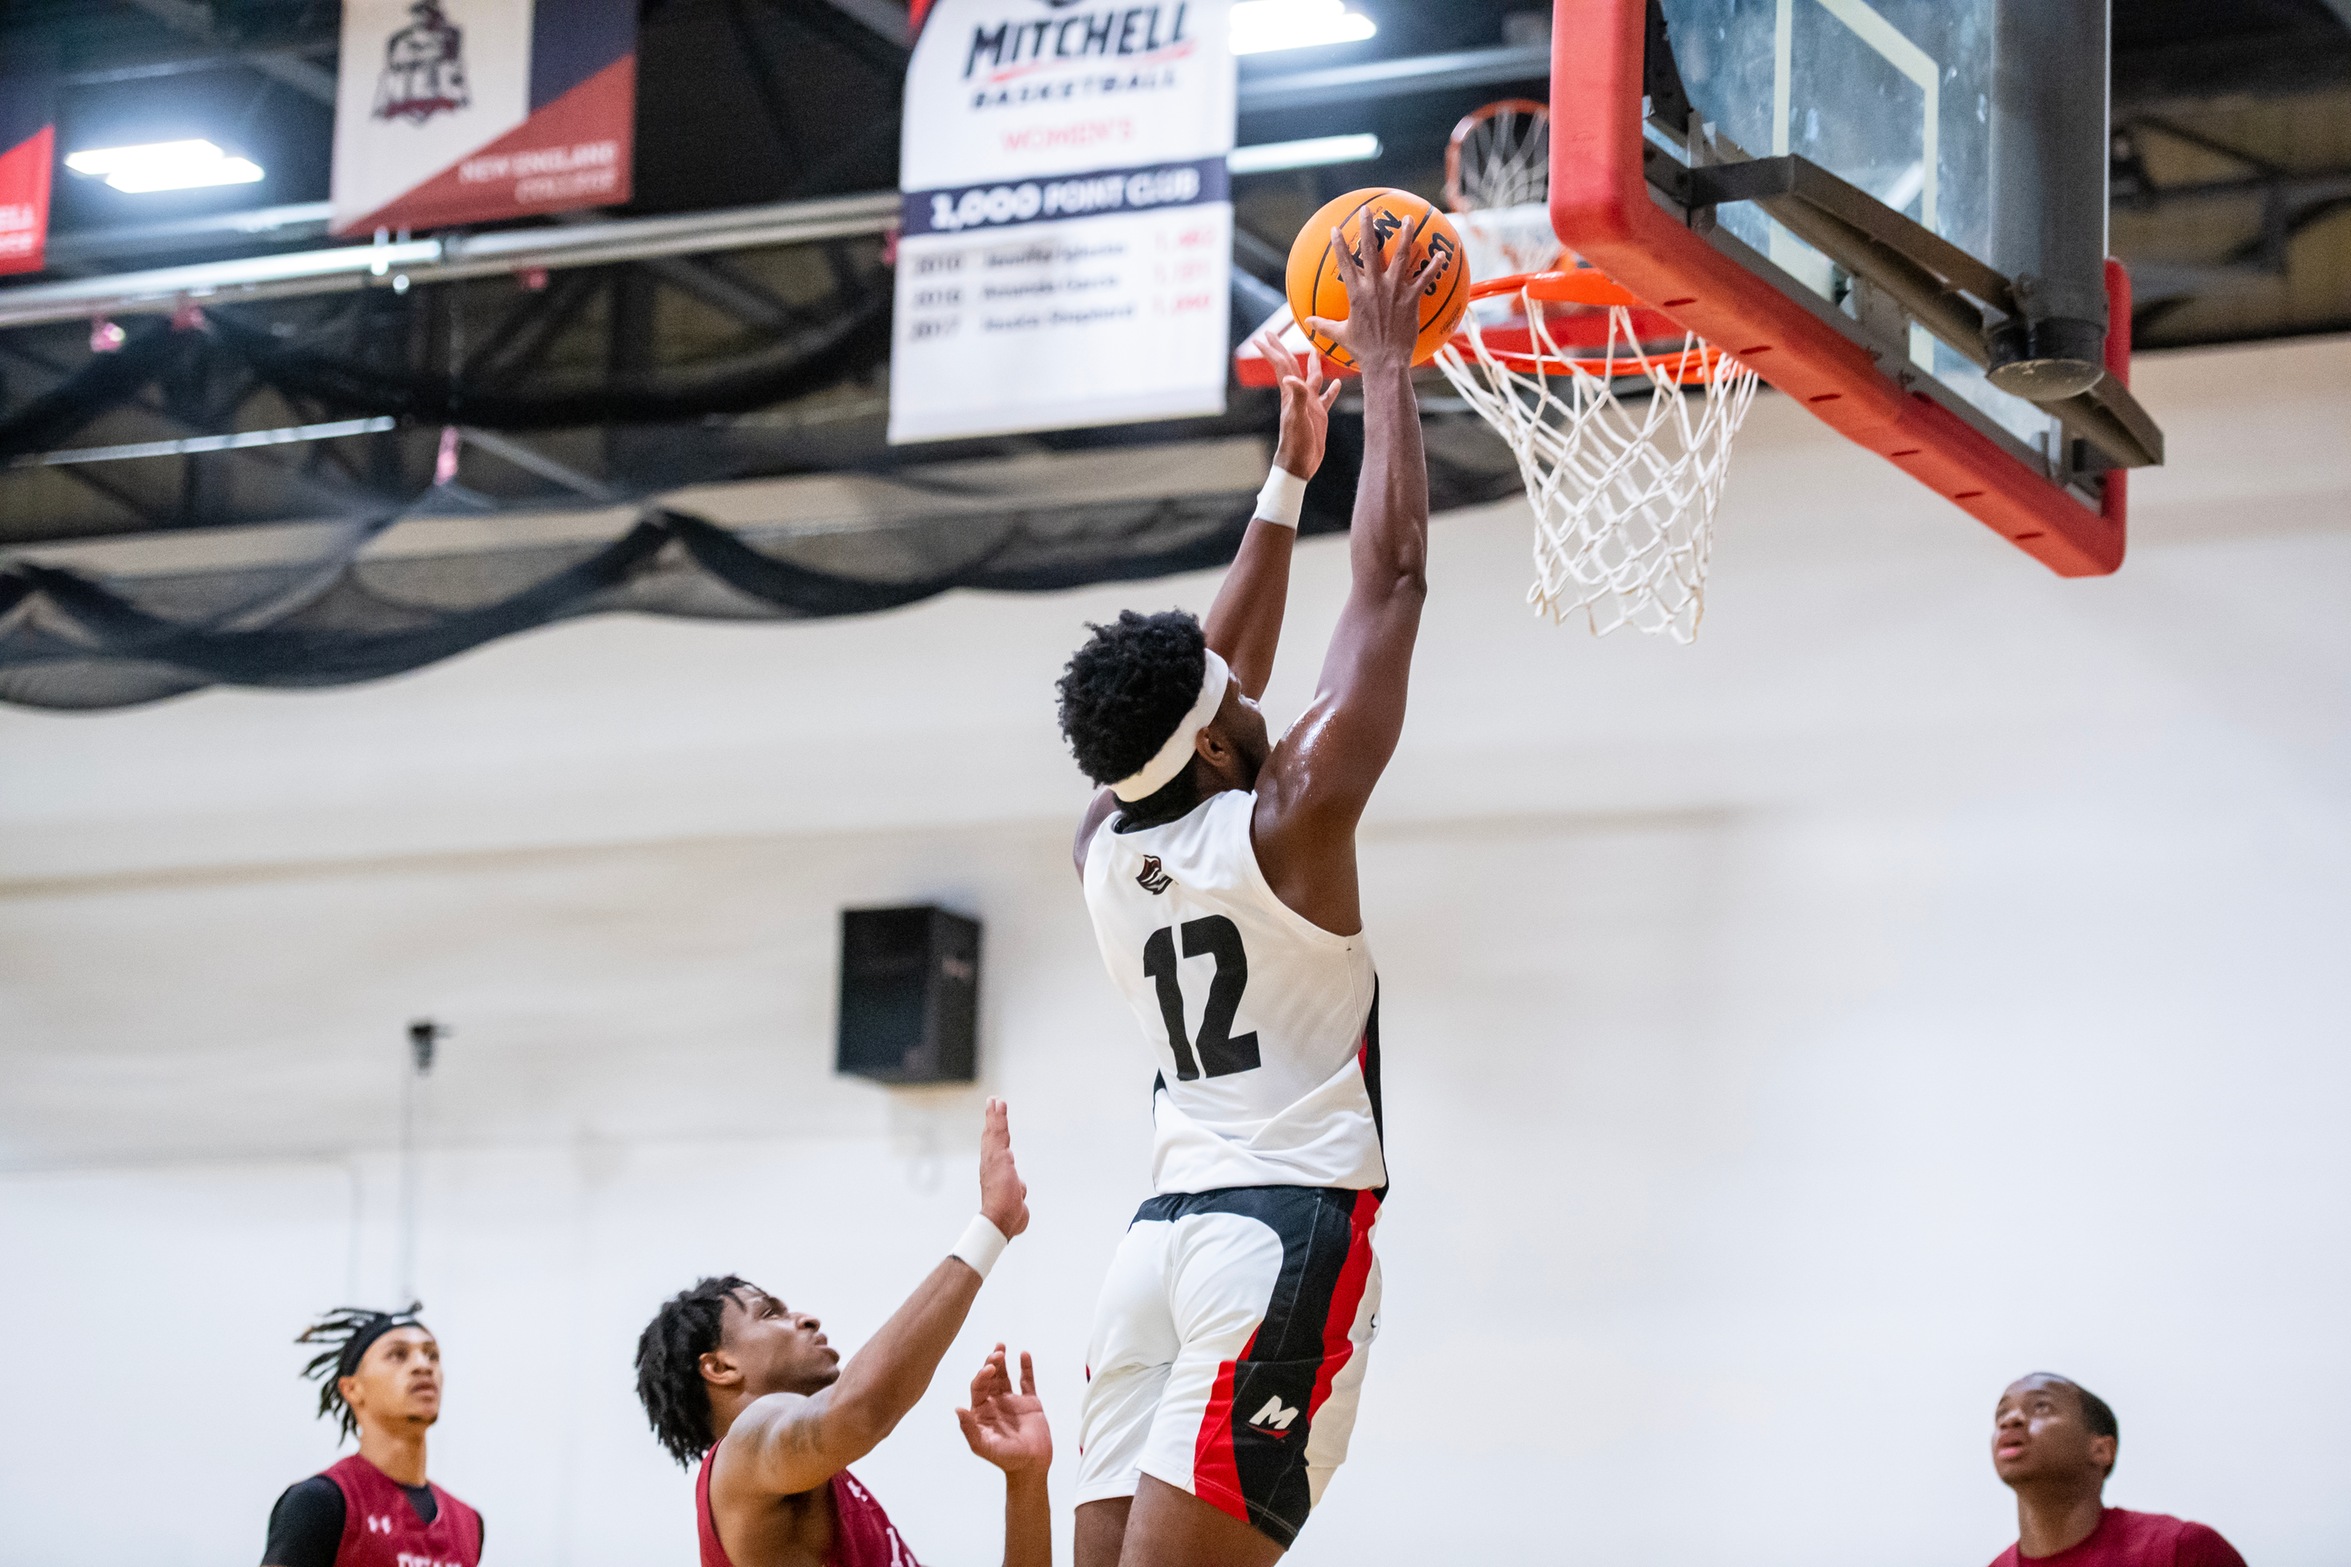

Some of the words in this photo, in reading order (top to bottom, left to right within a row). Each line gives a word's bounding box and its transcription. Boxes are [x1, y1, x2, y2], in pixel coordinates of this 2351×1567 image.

[964, 1, 1189, 80] MITCHELL
[973, 70, 1177, 109] BASKETBALL
[1003, 118, 1134, 151] WOMEN'S
[460, 158, 509, 183] NEW
[512, 142, 616, 175] ENGLAND
[930, 182, 1042, 231] 1,000
[1043, 174, 1126, 215] POINT
[1126, 167, 1199, 208] CLUB
[1143, 914, 1261, 1081] 12
[1249, 1395, 1299, 1429] M
